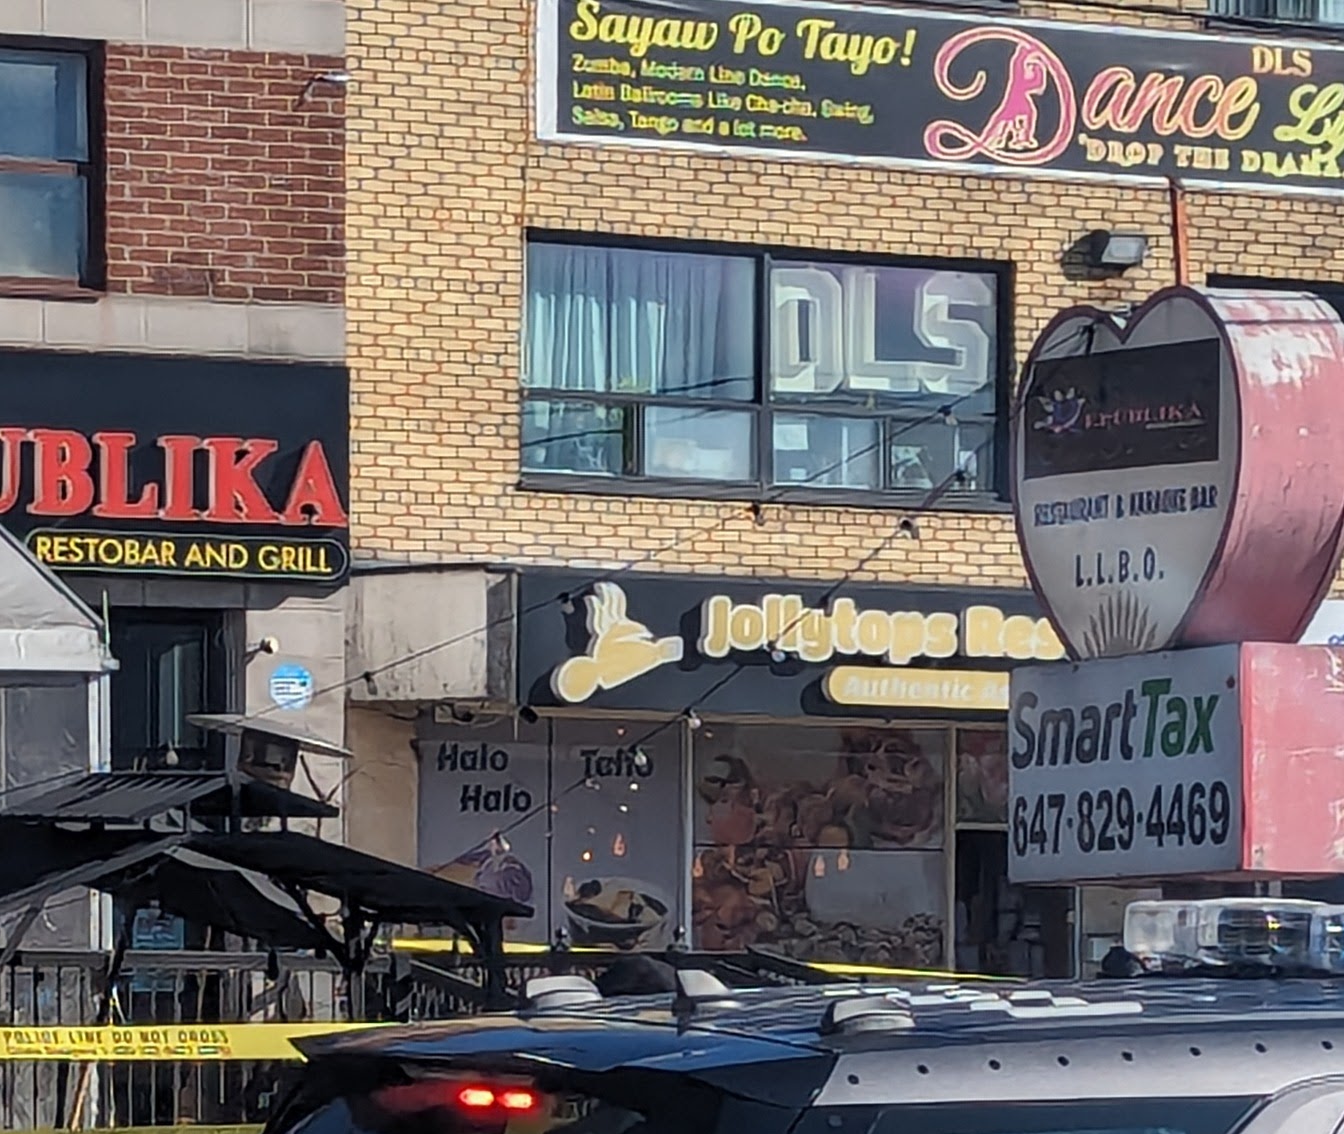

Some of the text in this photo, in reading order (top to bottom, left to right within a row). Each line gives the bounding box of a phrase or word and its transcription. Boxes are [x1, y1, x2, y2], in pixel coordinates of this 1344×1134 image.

[569, 0, 918, 75] Sayaw Po Tayo!
[1252, 45, 1313, 77] DLS
[924, 26, 1260, 166] Dance
[1174, 144, 1230, 171] THE
[770, 267, 993, 396] DLS
[36, 536, 333, 574] RESTOBAR AND GRILL
[703, 594, 959, 664] Jollytops
[843, 676, 973, 701] Authentic
[437, 742, 509, 772] Halo
[459, 783, 533, 813] Halo
